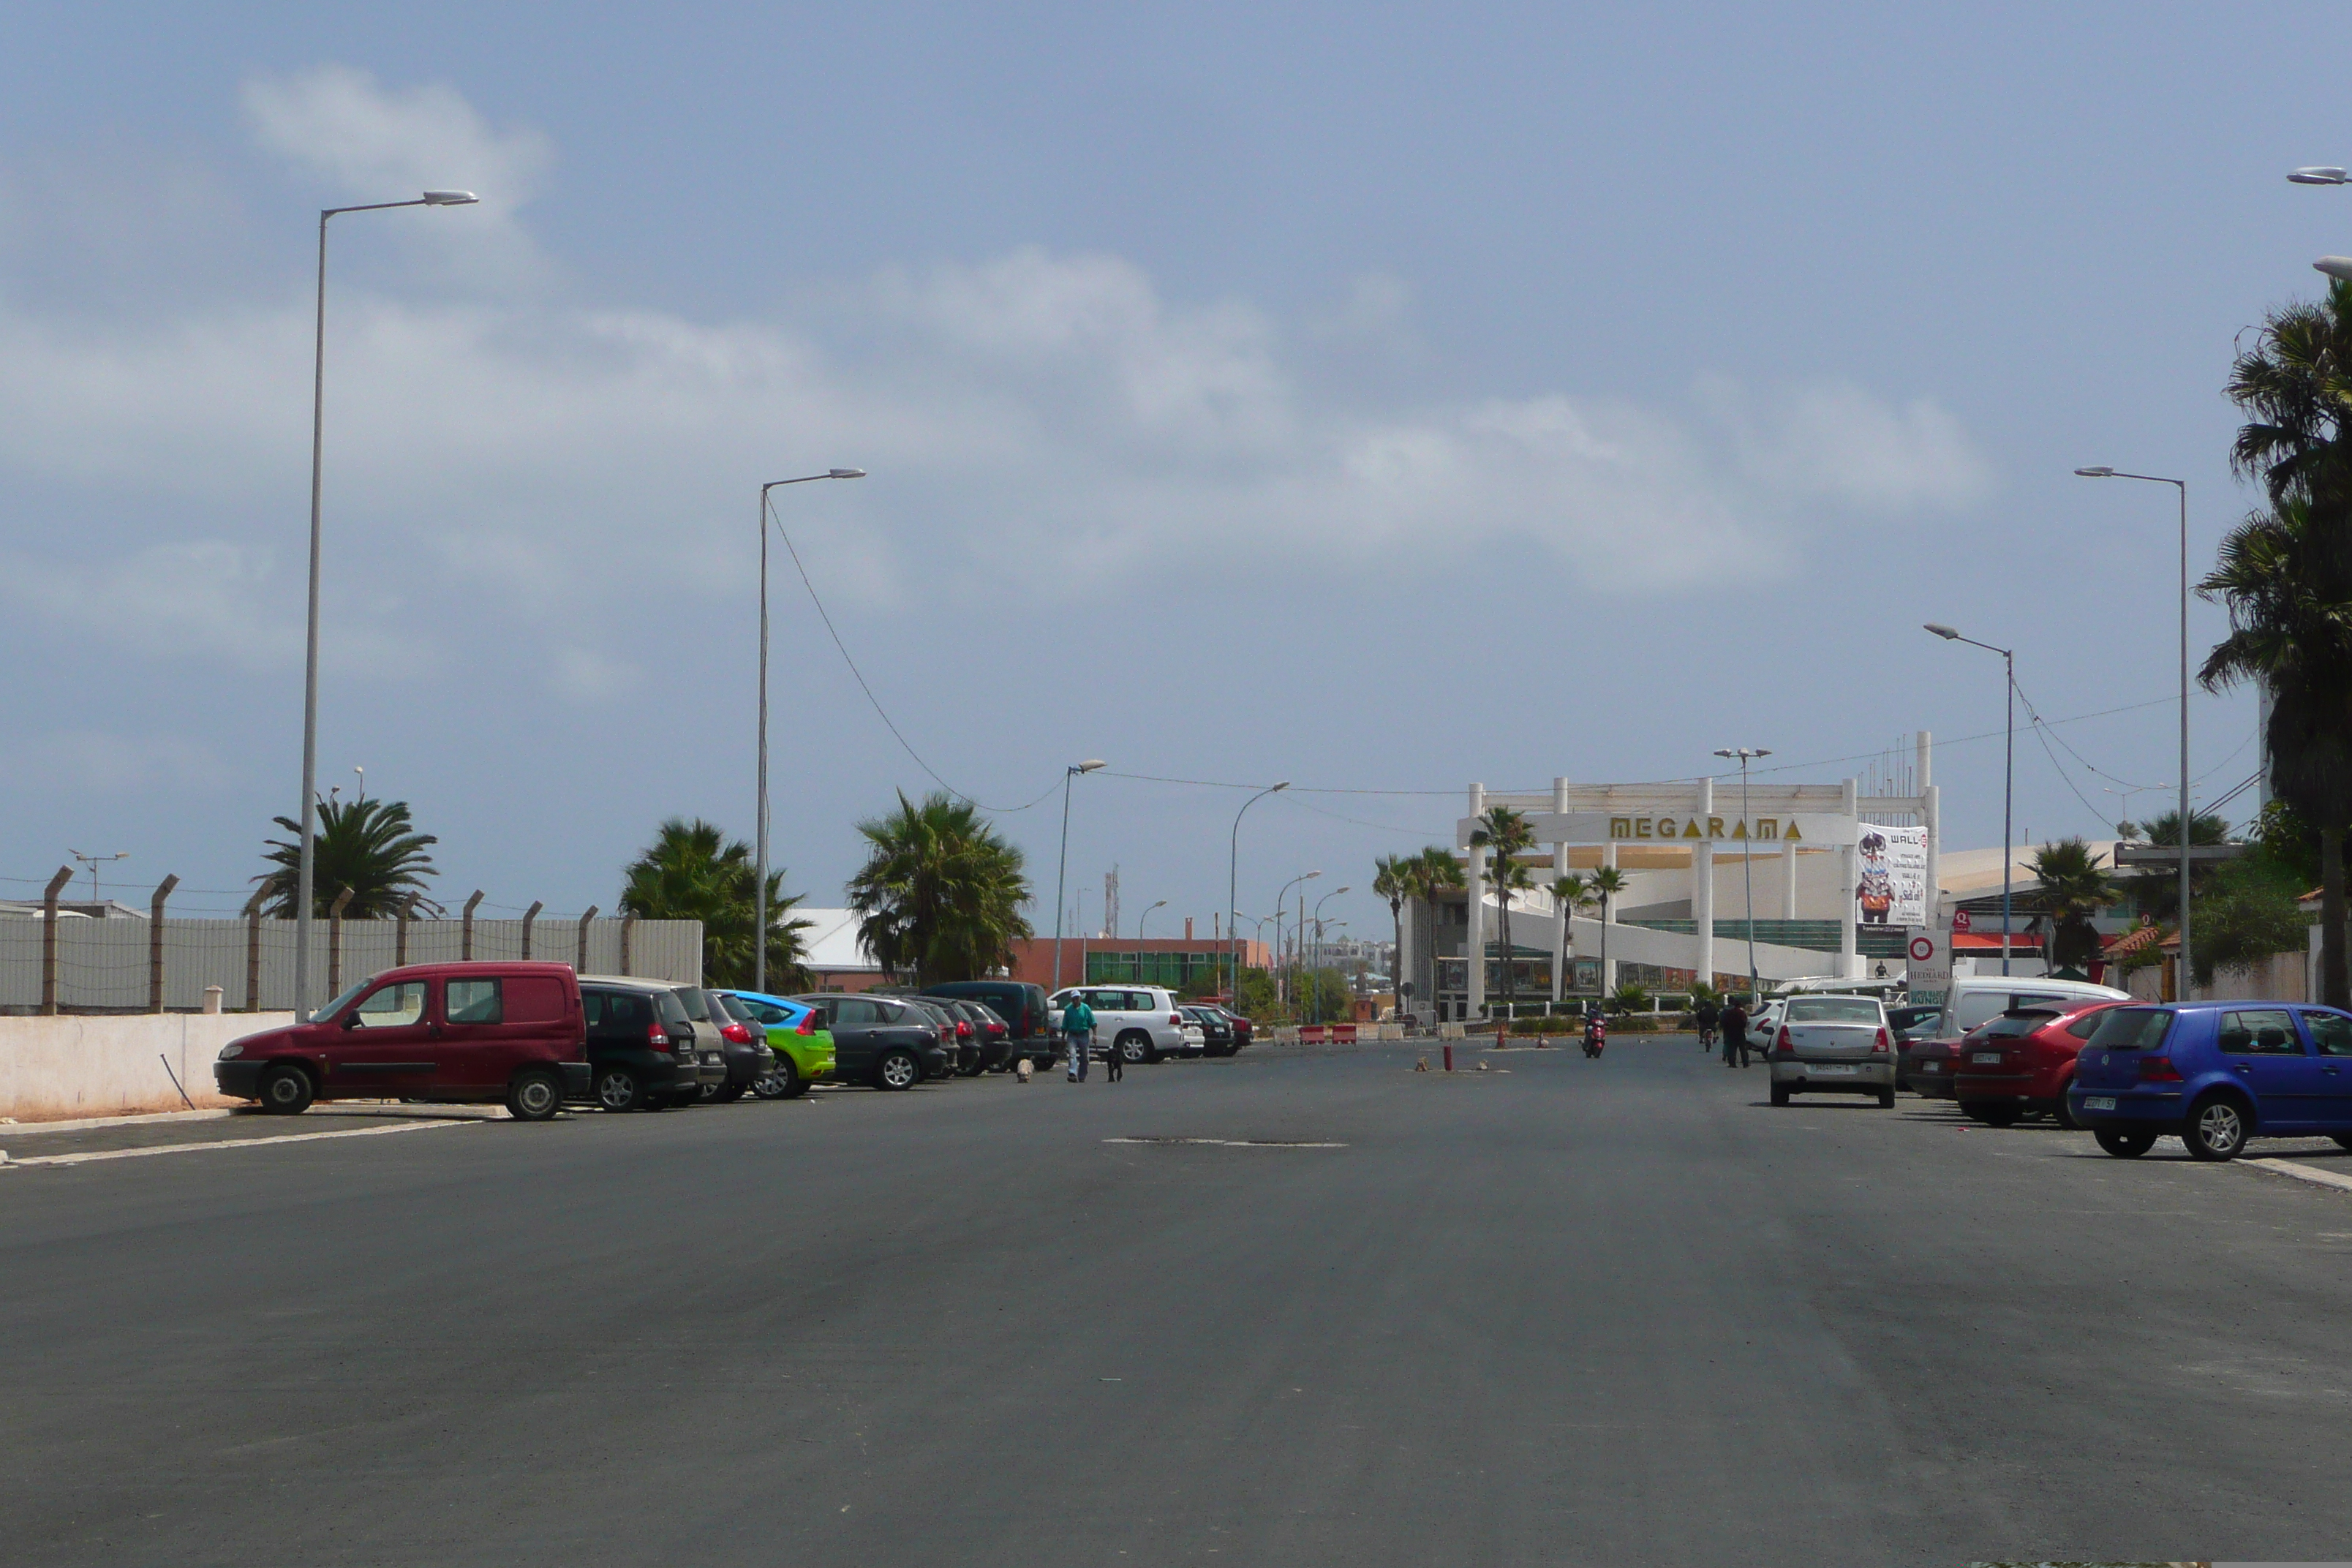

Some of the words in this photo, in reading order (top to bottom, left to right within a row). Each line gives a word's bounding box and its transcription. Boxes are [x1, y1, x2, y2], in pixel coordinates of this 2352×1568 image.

[1610, 817, 1802, 839] MEGARAMA
[1956, 912, 1967, 924] Q
[1910, 971, 1949, 980] HEDIARD
